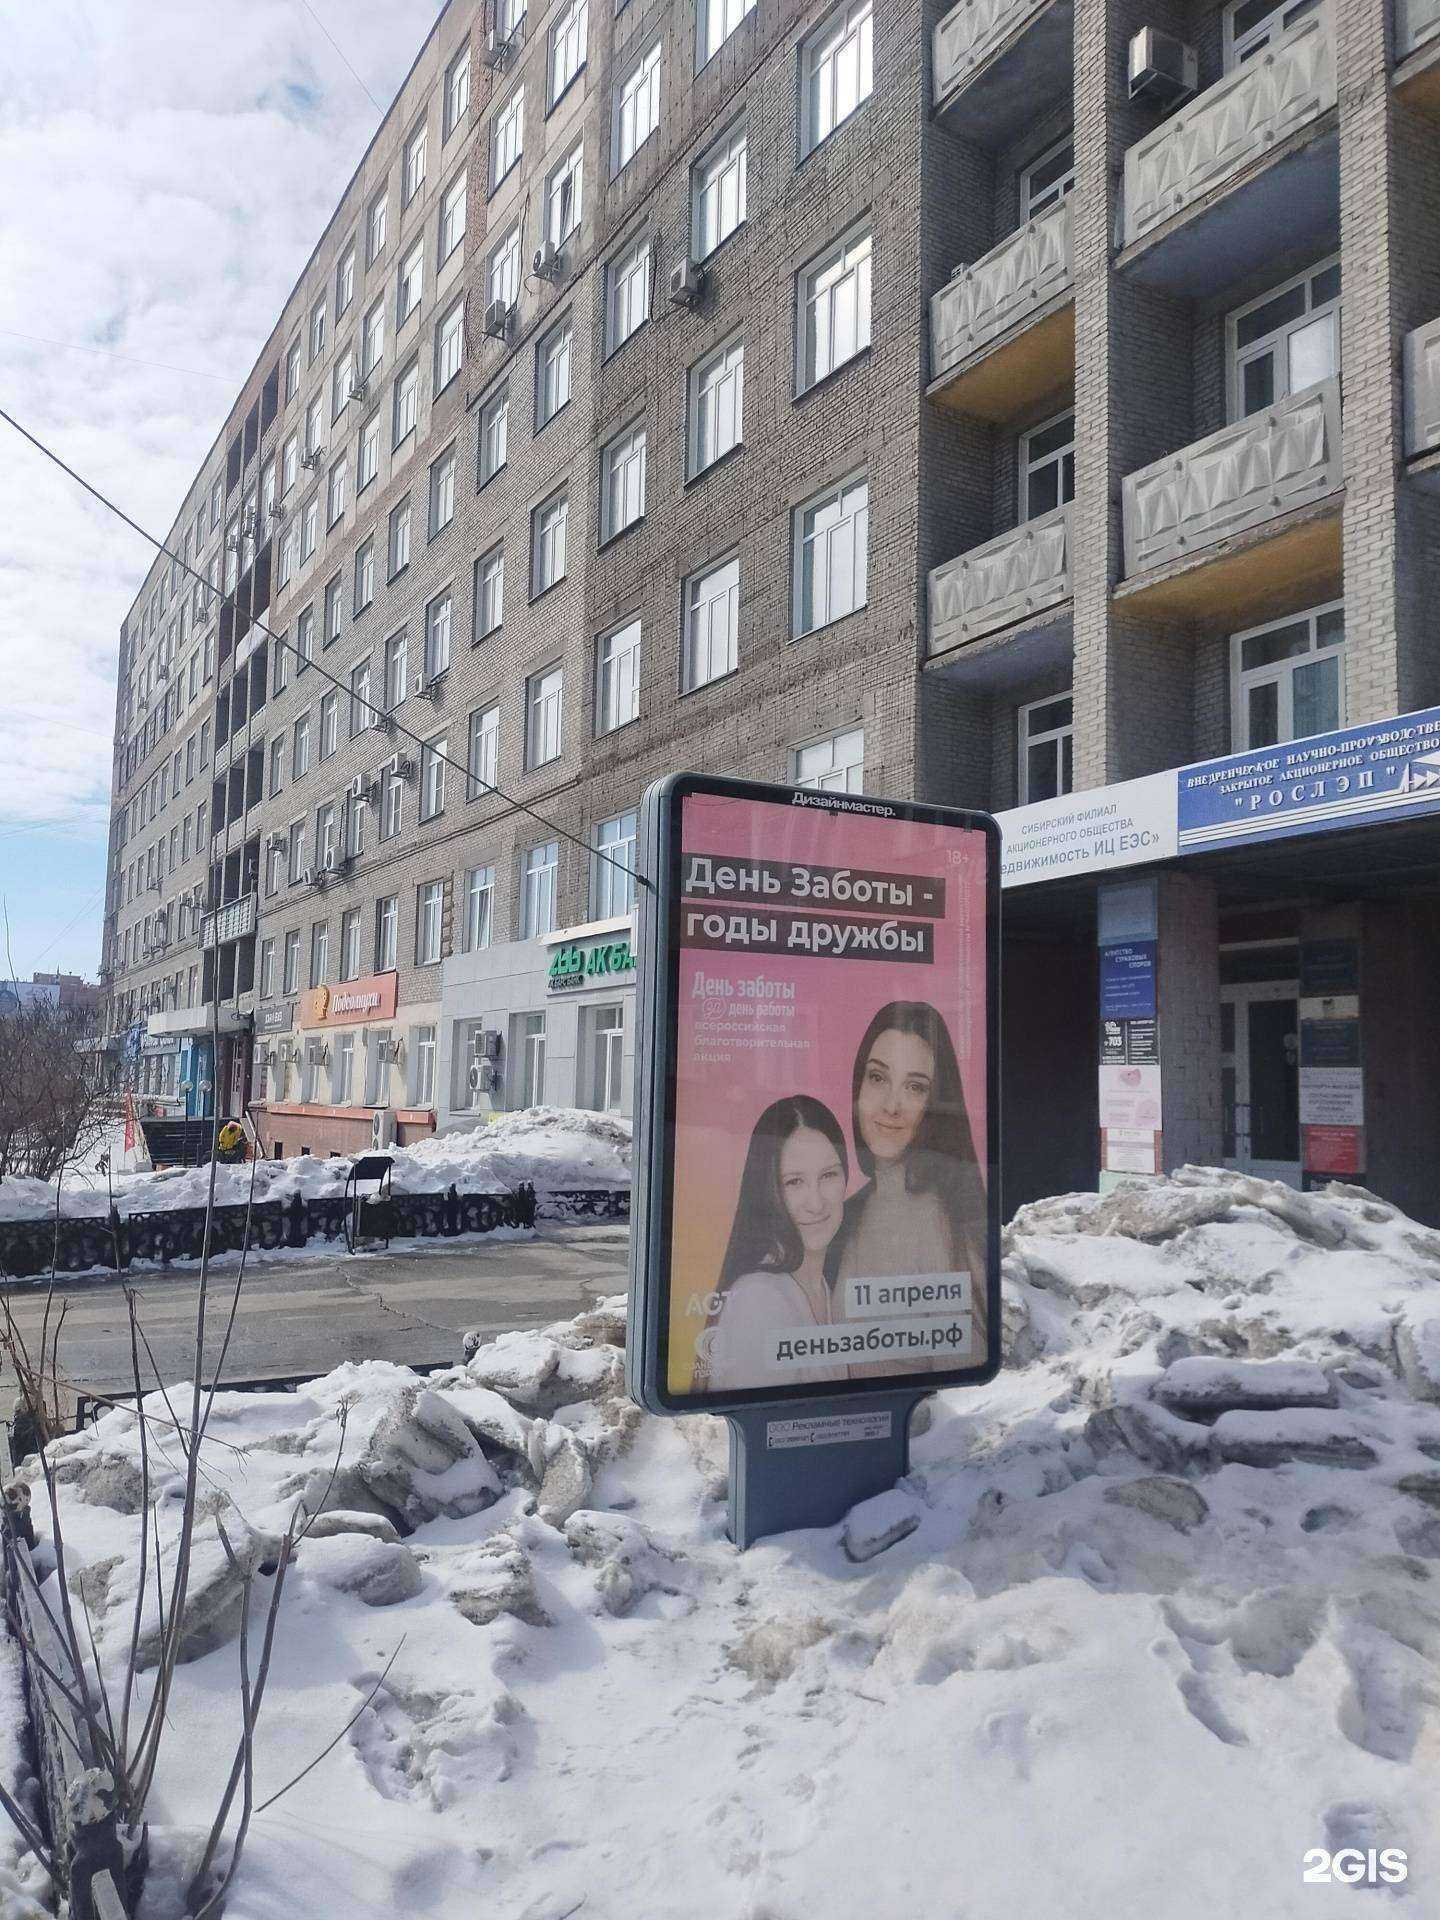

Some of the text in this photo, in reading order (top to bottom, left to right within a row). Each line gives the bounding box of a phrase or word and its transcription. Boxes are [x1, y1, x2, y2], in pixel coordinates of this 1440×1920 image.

[1220, 738, 1440, 794] ЗАКРЫТОЕ АКЦИОНЕРНОЕ ОБЩЕСТВО
[792, 791, 897, 817] Дизайнмастер.
[1022, 804, 1117, 835] СИБИРСКИЙ ФИЛИАЛ
[1006, 817, 1133, 855] АКЦИОНЕРНОГО ОБЩЕСТВА
[1094, 838, 1115, 857] ИЦ
[685, 857, 782, 895] День
[790, 867, 913, 906] Заботы
[686, 912, 925, 954] годы дружбы
[691, 971, 796, 999] День заботы
[853, 1281, 963, 1307] 11 апреля
[775, 1322, 963, 1361] деньзаботы.рф
